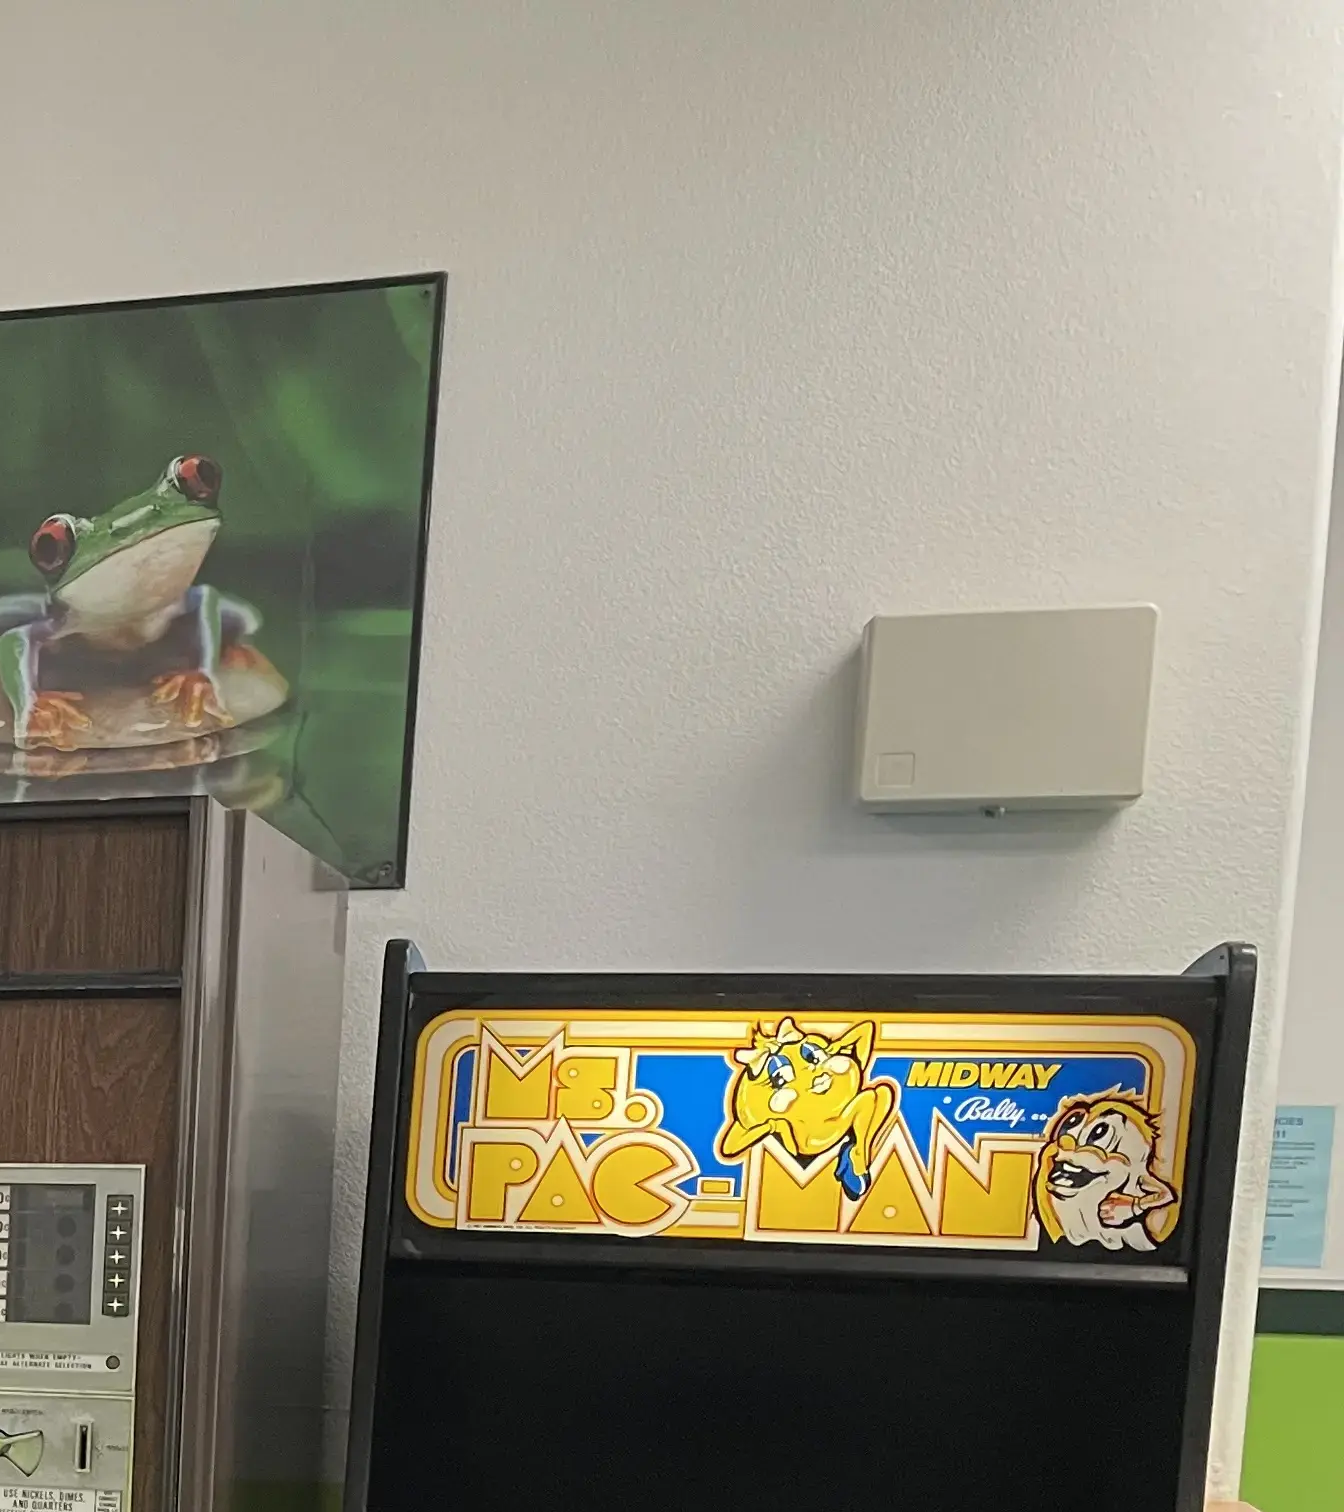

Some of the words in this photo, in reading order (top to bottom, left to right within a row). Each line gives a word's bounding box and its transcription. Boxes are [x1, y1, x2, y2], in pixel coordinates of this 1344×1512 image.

[480, 1024, 660, 1126] MS.
[906, 1061, 1062, 1090] MIDWAY
[954, 1096, 1026, 1129] Bally
[460, 1113, 1040, 1248] PAC-MAN
[3, 1489, 18, 1498] USE
[12, 1500, 29, 1509] AND
[32, 1501, 73, 1511] QUARTERS
